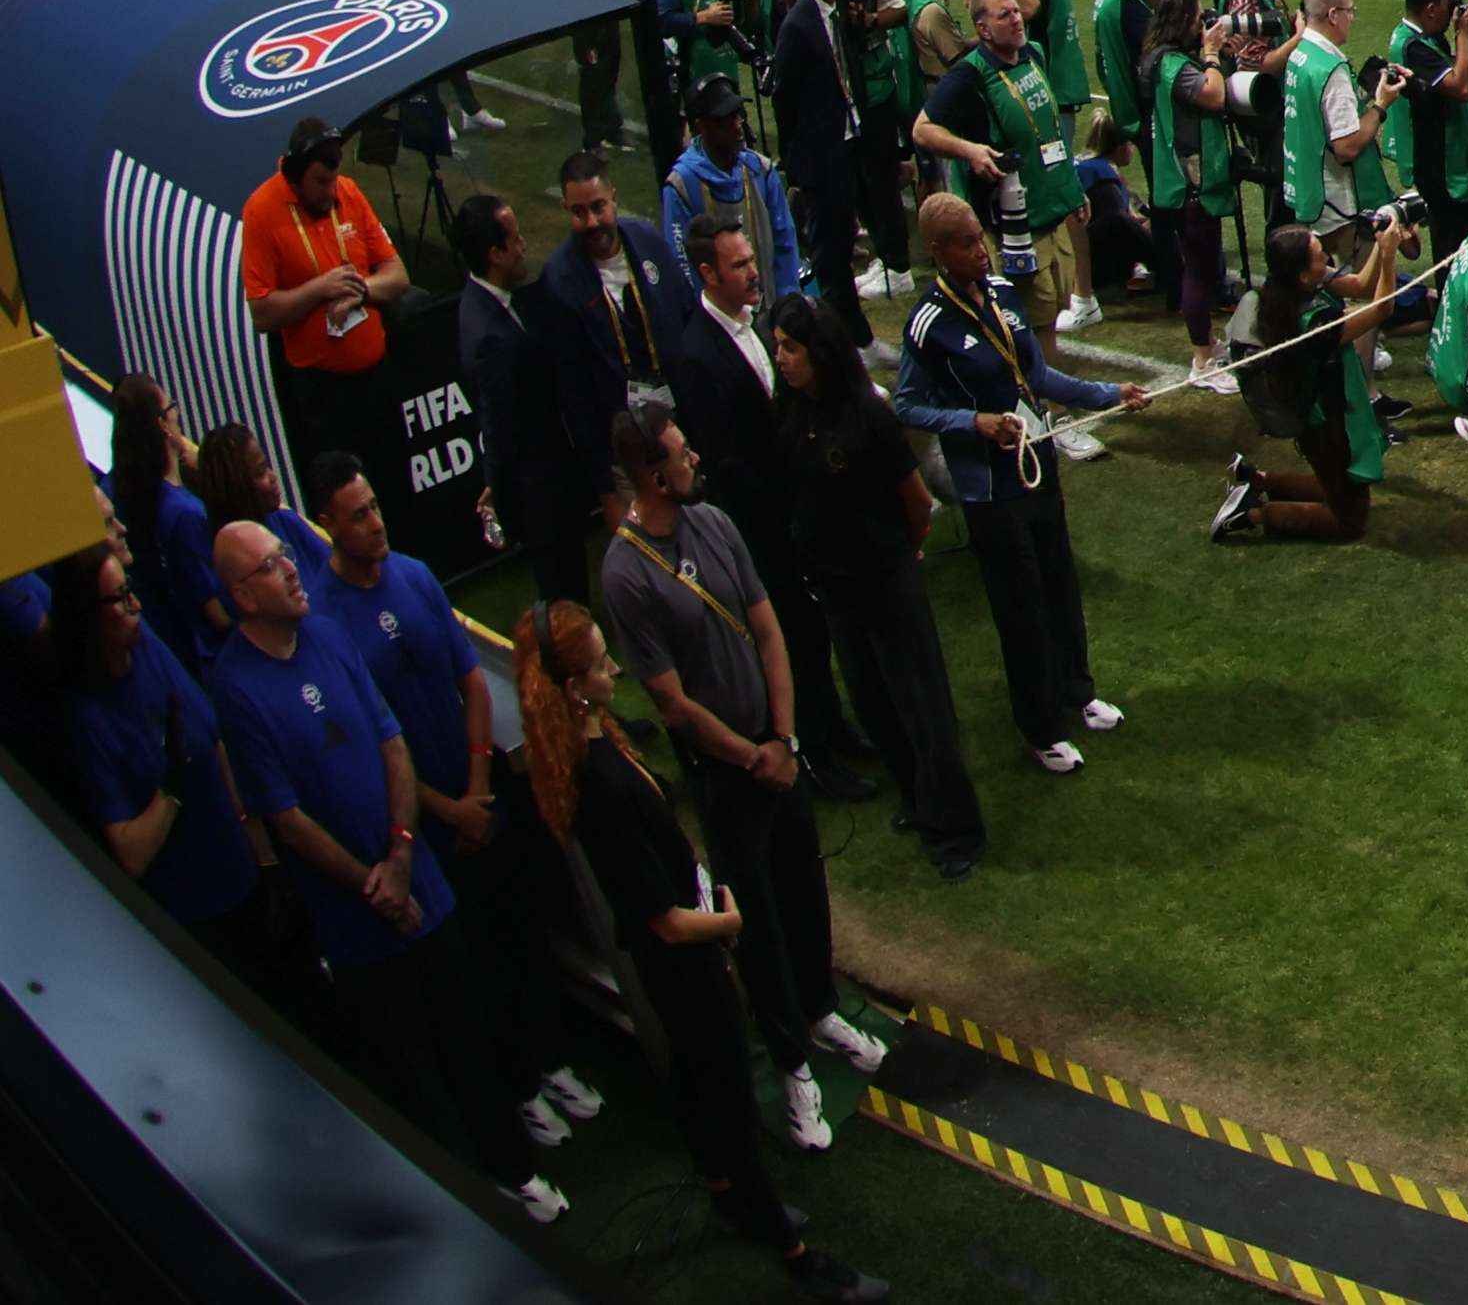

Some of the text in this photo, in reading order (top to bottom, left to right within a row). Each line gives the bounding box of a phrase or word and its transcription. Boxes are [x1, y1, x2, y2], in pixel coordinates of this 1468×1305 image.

[218, 47, 309, 100] SAINT GERMAIN
[402, 381, 473, 439] FIFA
[408, 435, 475, 493] RLD
